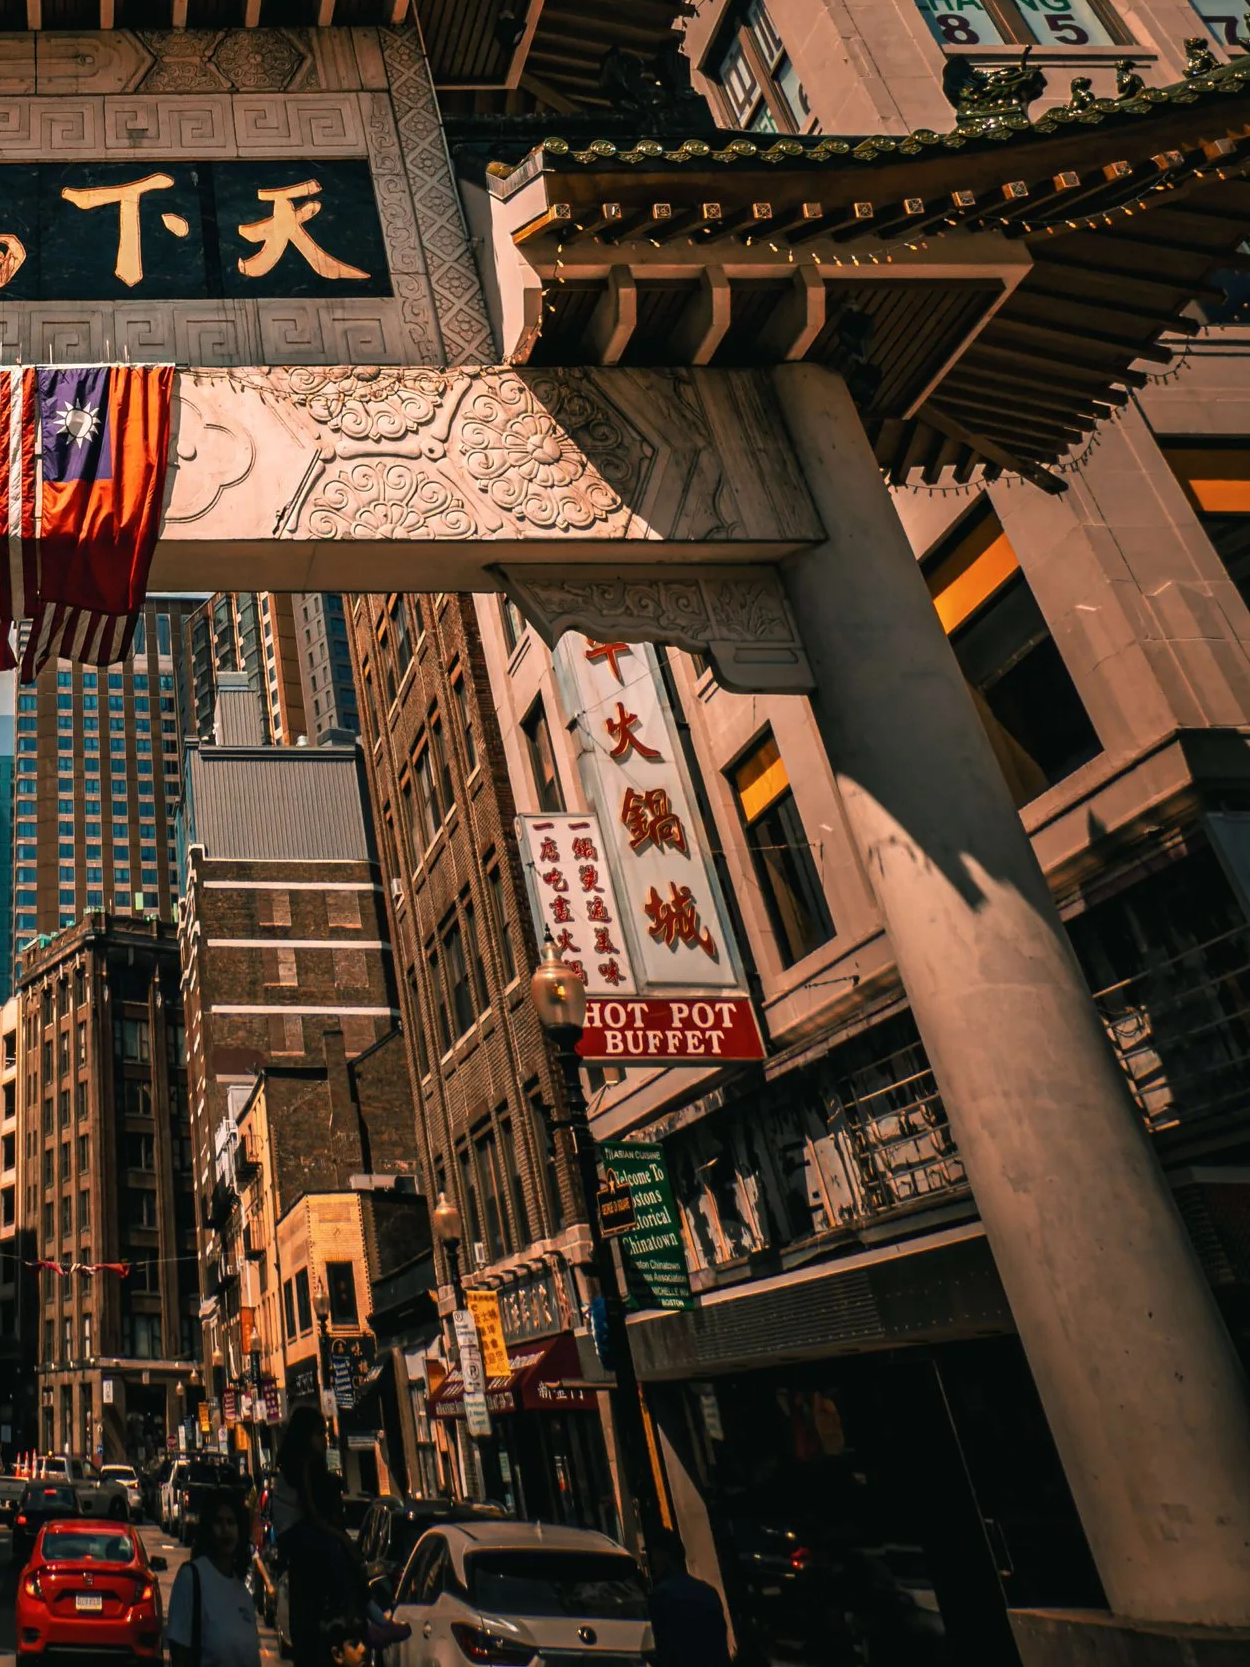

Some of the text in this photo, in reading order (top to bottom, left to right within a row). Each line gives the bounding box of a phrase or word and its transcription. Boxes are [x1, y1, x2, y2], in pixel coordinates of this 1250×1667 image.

[937, 14, 1090, 45] 8 5
[583, 1002, 737, 1028] HOT POT
[604, 1030, 726, 1054] BUFFET
[613, 1149, 634, 1159] ASIAN
[649, 1163, 665, 1182] To
